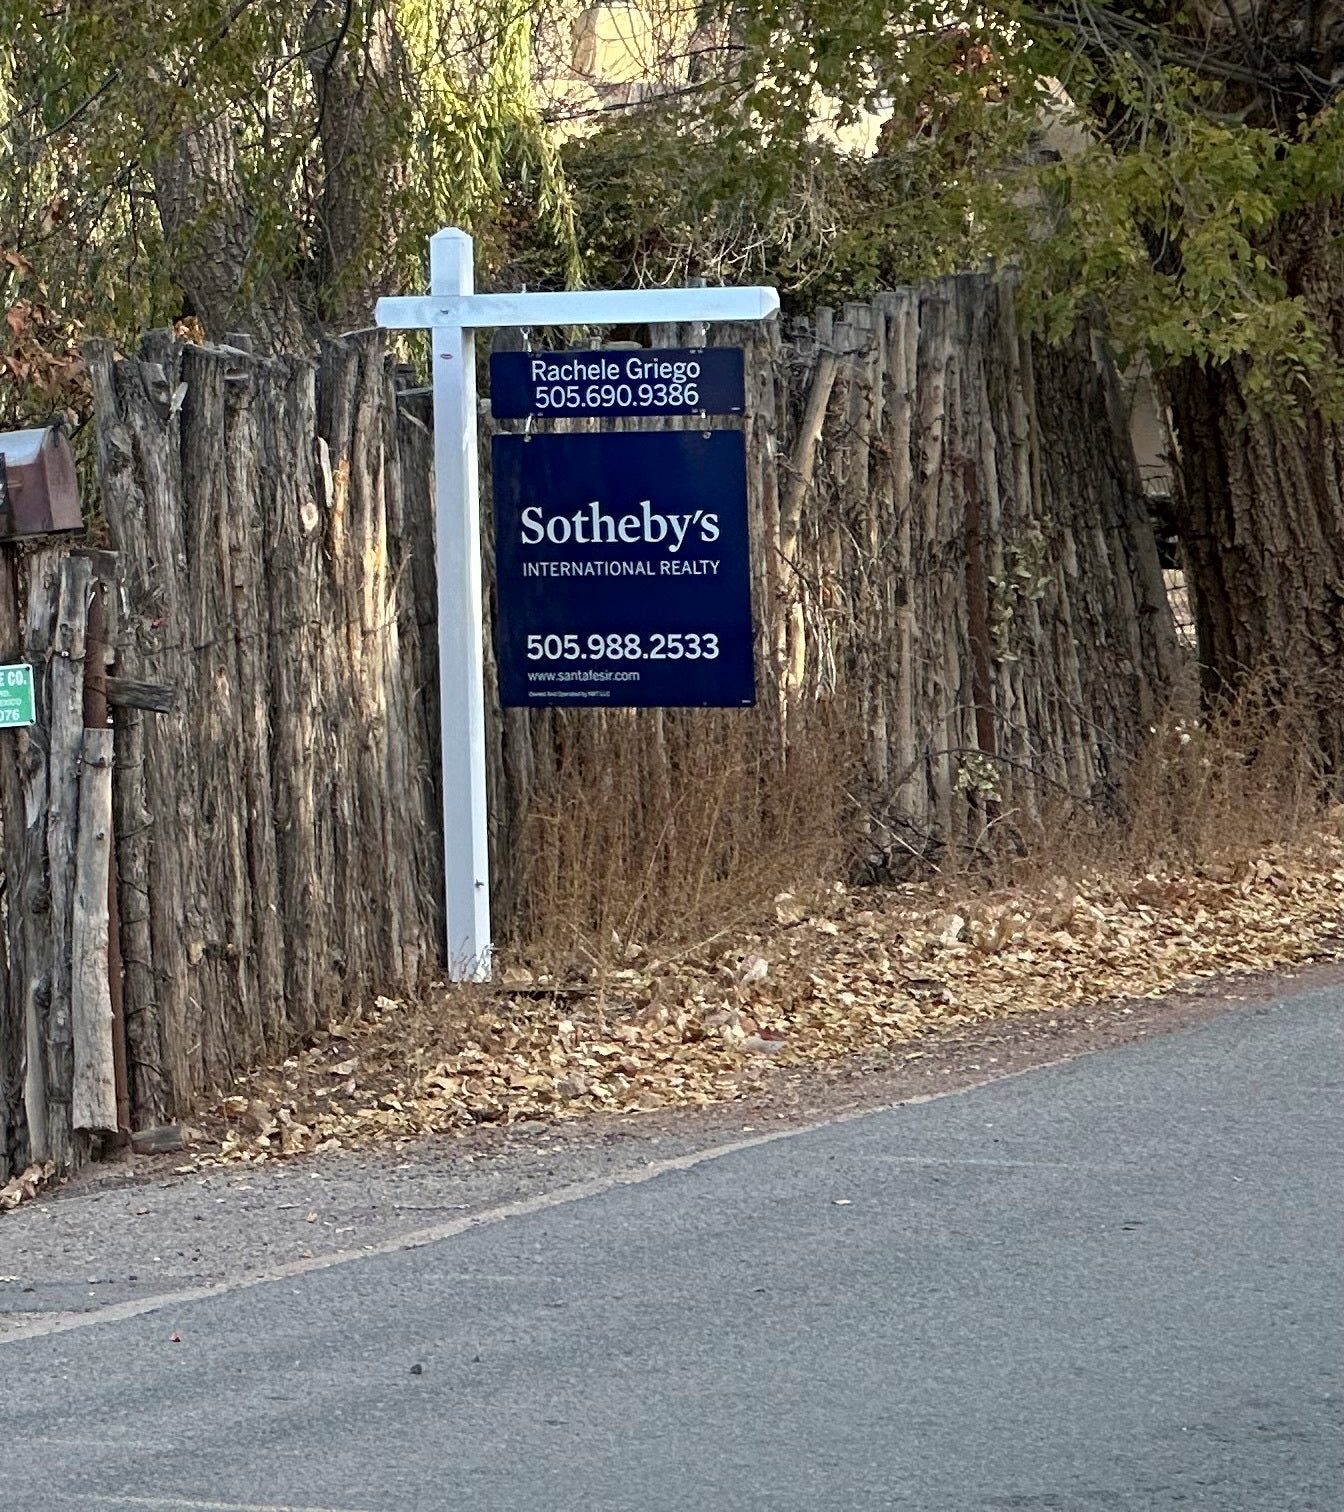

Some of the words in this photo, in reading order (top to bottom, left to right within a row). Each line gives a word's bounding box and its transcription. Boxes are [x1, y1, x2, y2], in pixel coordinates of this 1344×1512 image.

[532, 359, 620, 381] Rachele
[626, 357, 700, 383] Griego
[535, 383, 700, 409] 505.690.9386
[521, 500, 720, 553] Sotheby's
[523, 561, 655, 576] INTERNATIONAL
[660, 560, 720, 575] REALTY
[527, 633, 719, 660] 505.988.2533
[7, 670, 27, 687] CO.
[527, 669, 640, 681] www.santafesir.com
